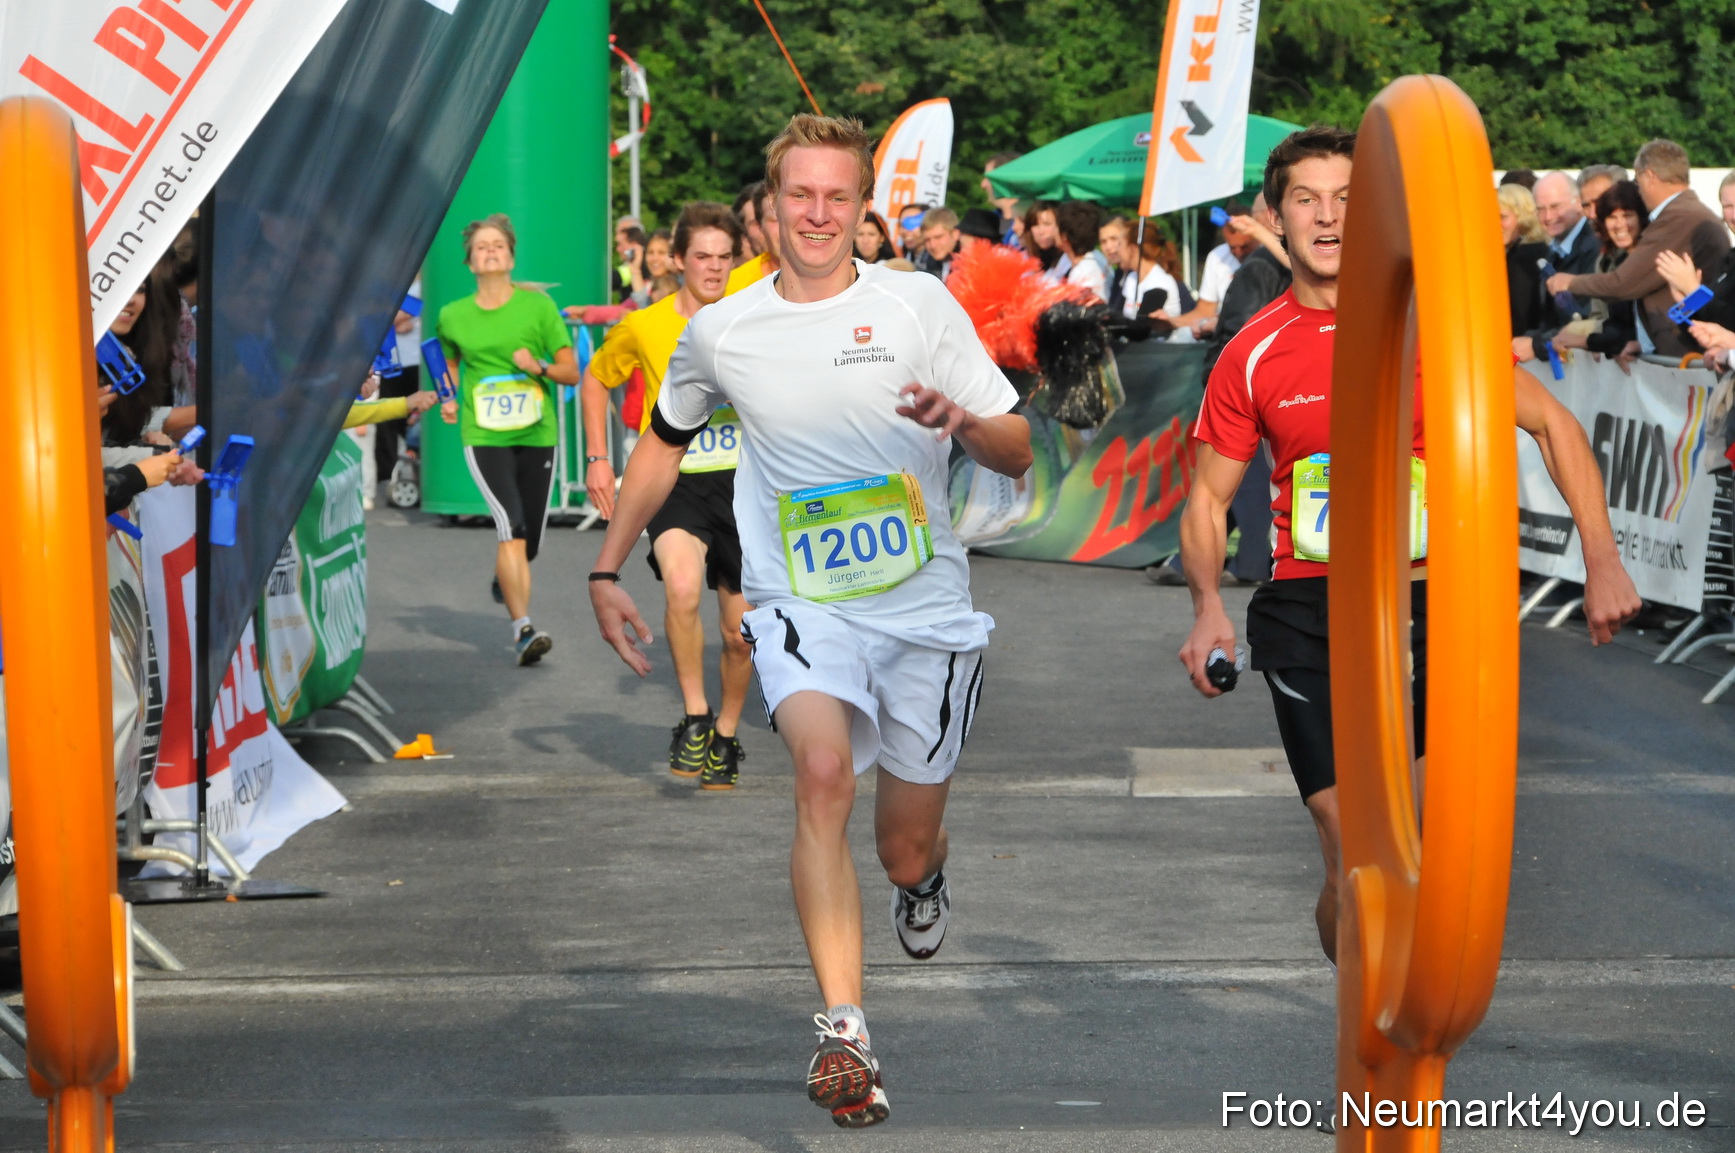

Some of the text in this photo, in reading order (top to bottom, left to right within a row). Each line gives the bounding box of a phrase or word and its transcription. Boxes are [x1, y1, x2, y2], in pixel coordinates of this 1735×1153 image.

[91, 121, 219, 312] ann-net.de
[834, 353, 895, 367] Lammsbräu
[842, 346, 887, 356] Neumarkter
[482, 393, 527, 417] 797
[1310, 491, 1329, 533] 7
[792, 515, 908, 574] 1200
[828, 569, 867, 586] Jürgen
